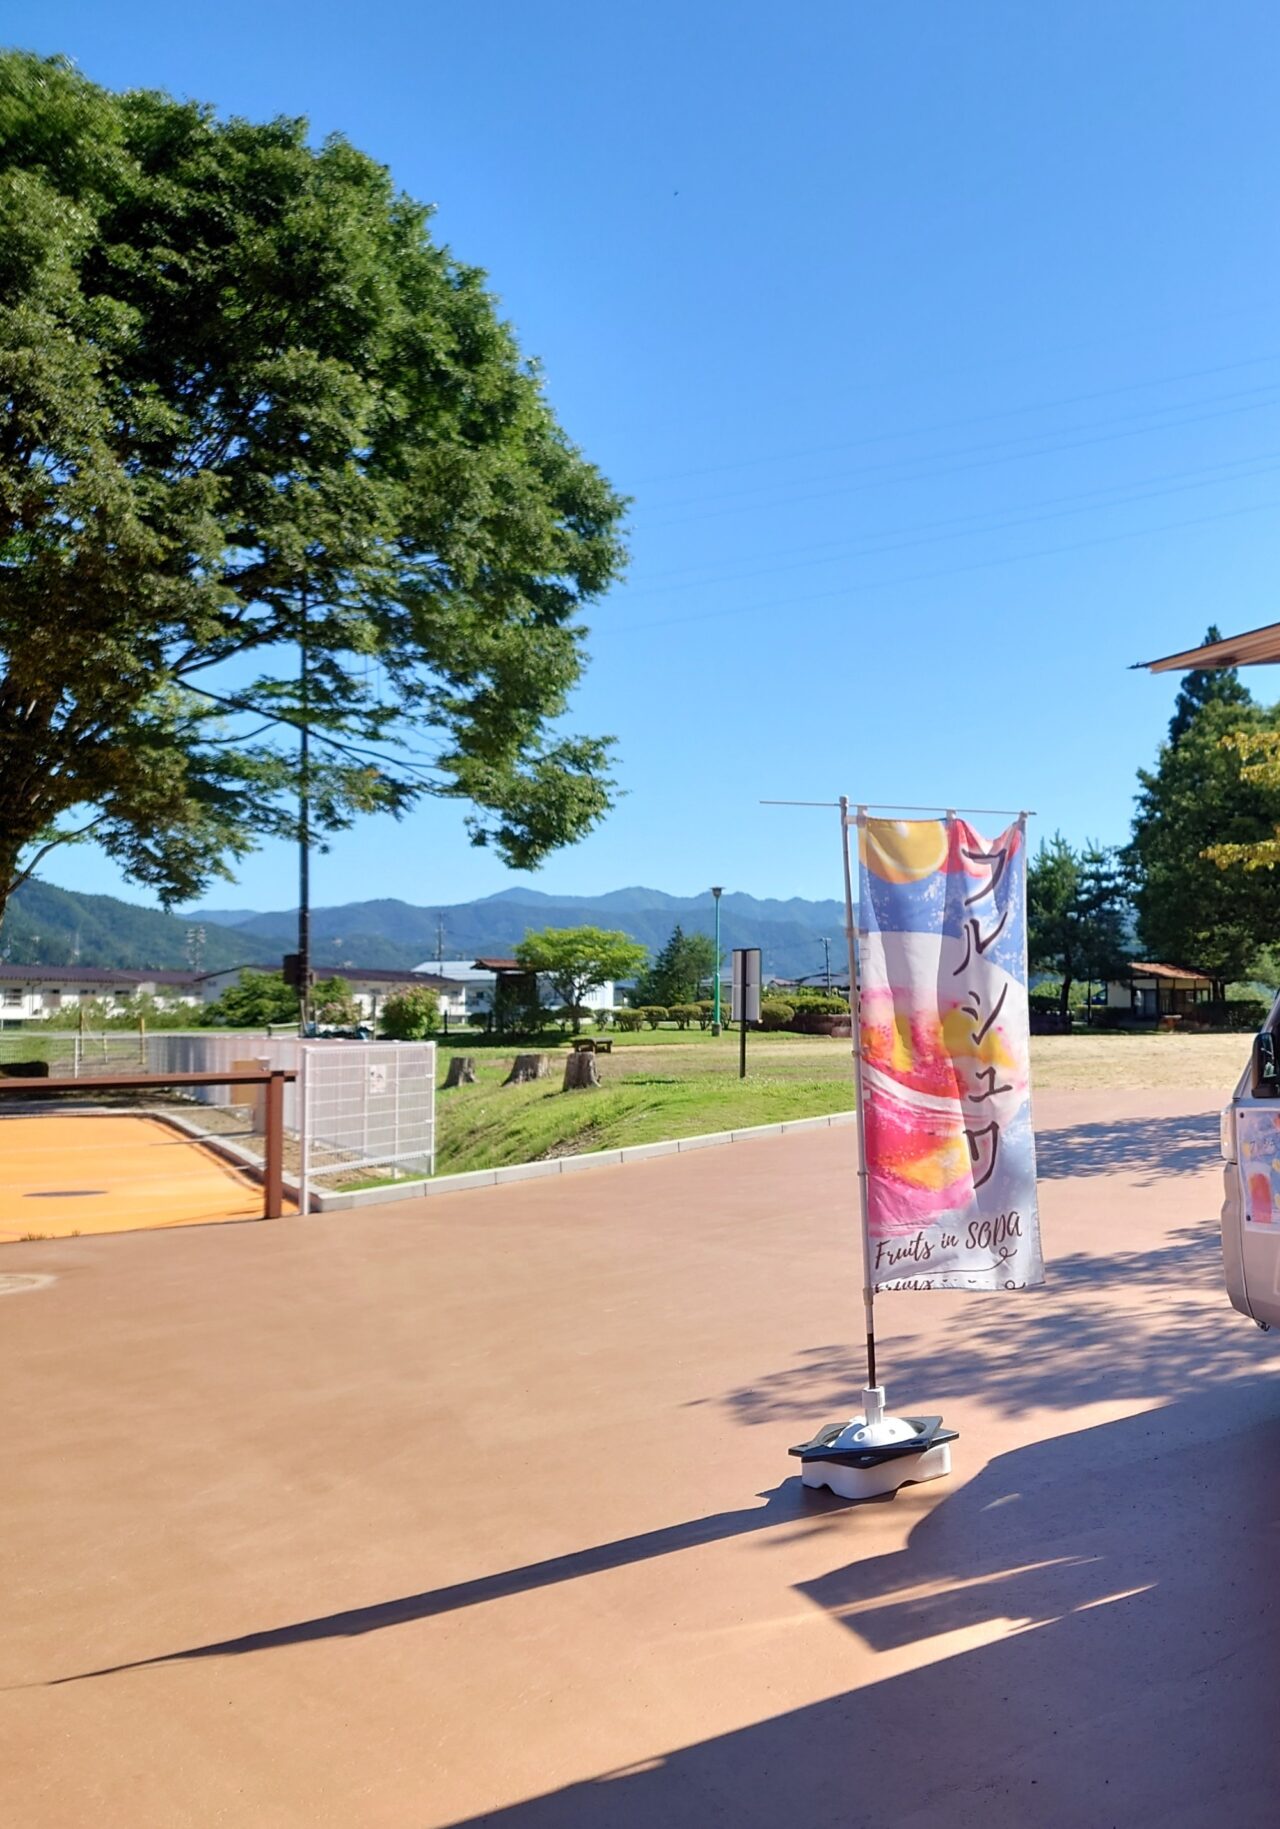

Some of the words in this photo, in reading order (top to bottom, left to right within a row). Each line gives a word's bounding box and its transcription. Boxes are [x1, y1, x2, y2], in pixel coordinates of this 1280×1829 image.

[952, 848, 1013, 1190] フルシュワ
[875, 1231, 935, 1270] Fruits
[941, 1232, 959, 1249] in
[966, 1210, 1023, 1250] SODA
